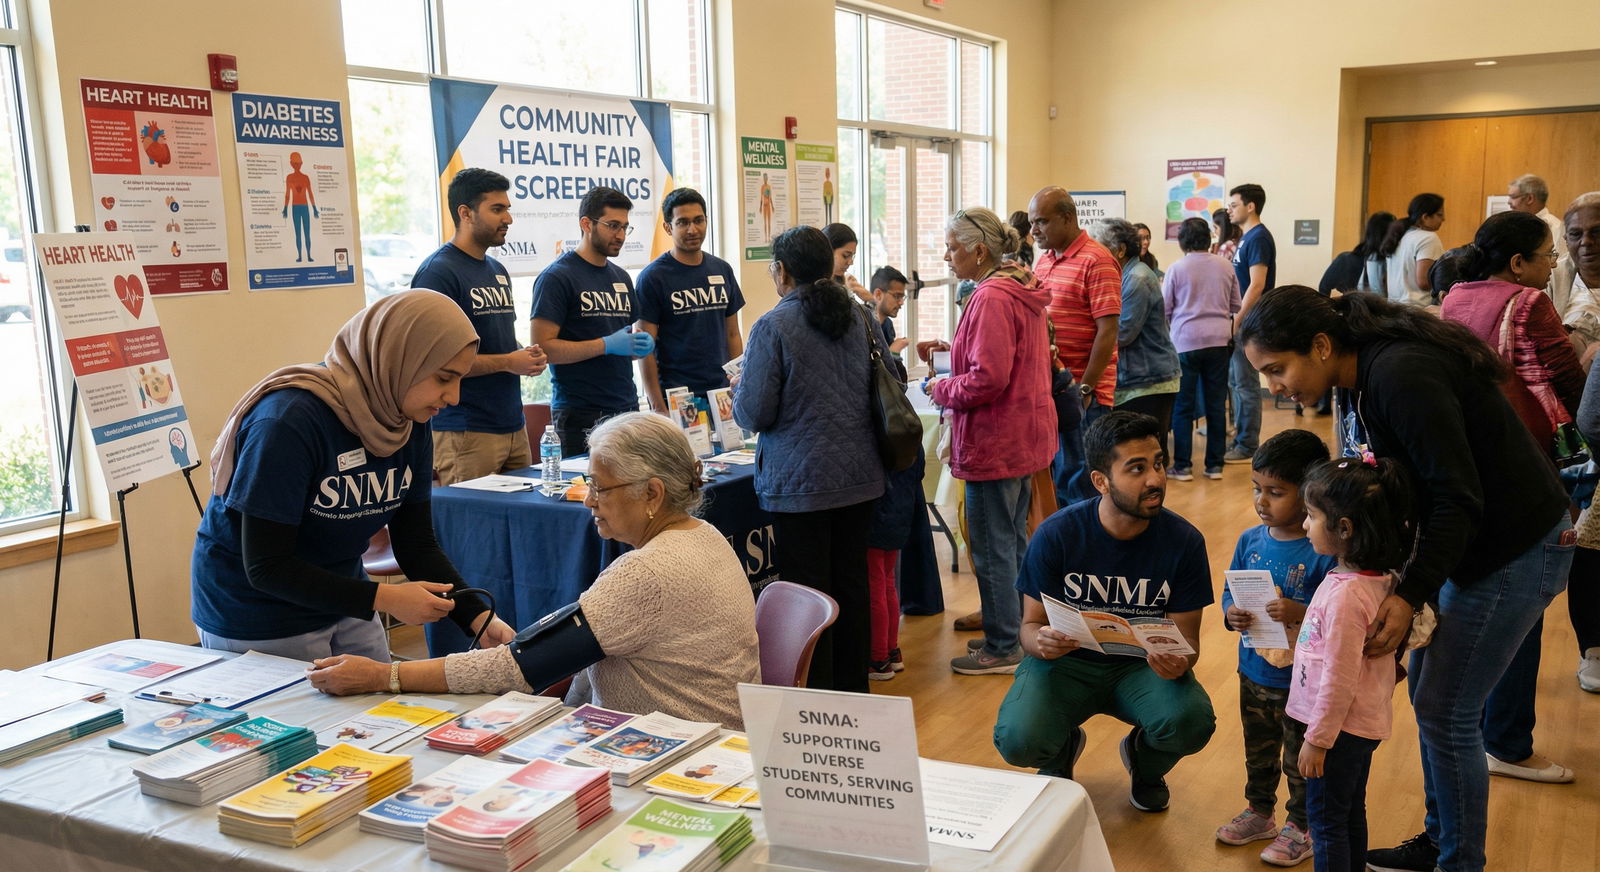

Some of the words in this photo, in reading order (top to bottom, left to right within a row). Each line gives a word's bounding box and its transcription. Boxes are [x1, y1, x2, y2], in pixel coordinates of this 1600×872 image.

[86, 87, 143, 107] HEART
[148, 92, 208, 110] HEALTH
[242, 101, 335, 123] DIABETES
[499, 104, 637, 137] COMMUNITY
[241, 123, 339, 142] AWARENESS
[498, 139, 588, 167] HEALTH
[595, 145, 641, 169] FAIR
[748, 141, 780, 153] MENTAL
[744, 153, 785, 166] WELLNESS
[43, 245, 87, 266] HEART
[89, 243, 136, 263] HEALTH
[500, 241, 537, 256] SNMA
[580, 290, 631, 312] SNMA
[671, 286, 729, 310] SNMA
[313, 464, 413, 509] SNMA
[1064, 572, 1171, 607] SNMA
[798, 709, 859, 729] SNMA:
[782, 731, 881, 753] SUPPORTING
[802, 751, 865, 770] DIVERSE
[762, 766, 843, 787] STUDENTS,
[847, 775, 914, 793] SERVING
[785, 786, 895, 810] COMMUNITIES
[644, 813, 716, 831] WELLNESS
[659, 809, 713, 825] MENTAL
[928, 826, 977, 840] SNMA
